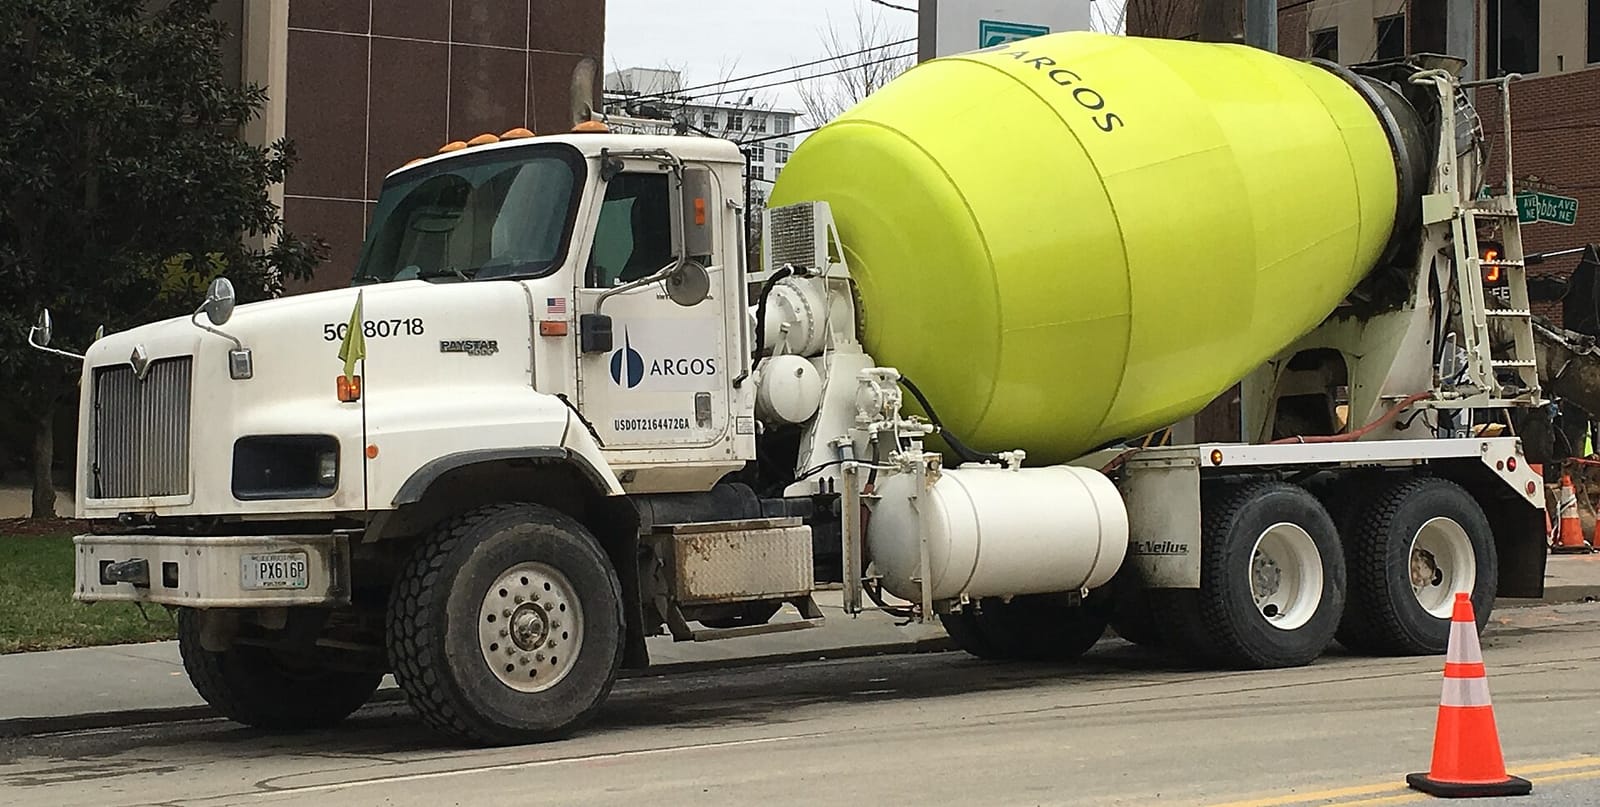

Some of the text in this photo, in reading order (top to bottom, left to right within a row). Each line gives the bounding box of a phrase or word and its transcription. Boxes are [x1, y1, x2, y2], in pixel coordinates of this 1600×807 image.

[999, 51, 1124, 132] ARGOS
[1524, 197, 1537, 208] AVE
[1558, 199, 1576, 211] AVE
[1526, 209, 1536, 219] NE
[1558, 210, 1573, 222] NE
[440, 340, 498, 352] PAYSTAR
[650, 358, 716, 376] ARGOS
[260, 562, 304, 579] PX616P
